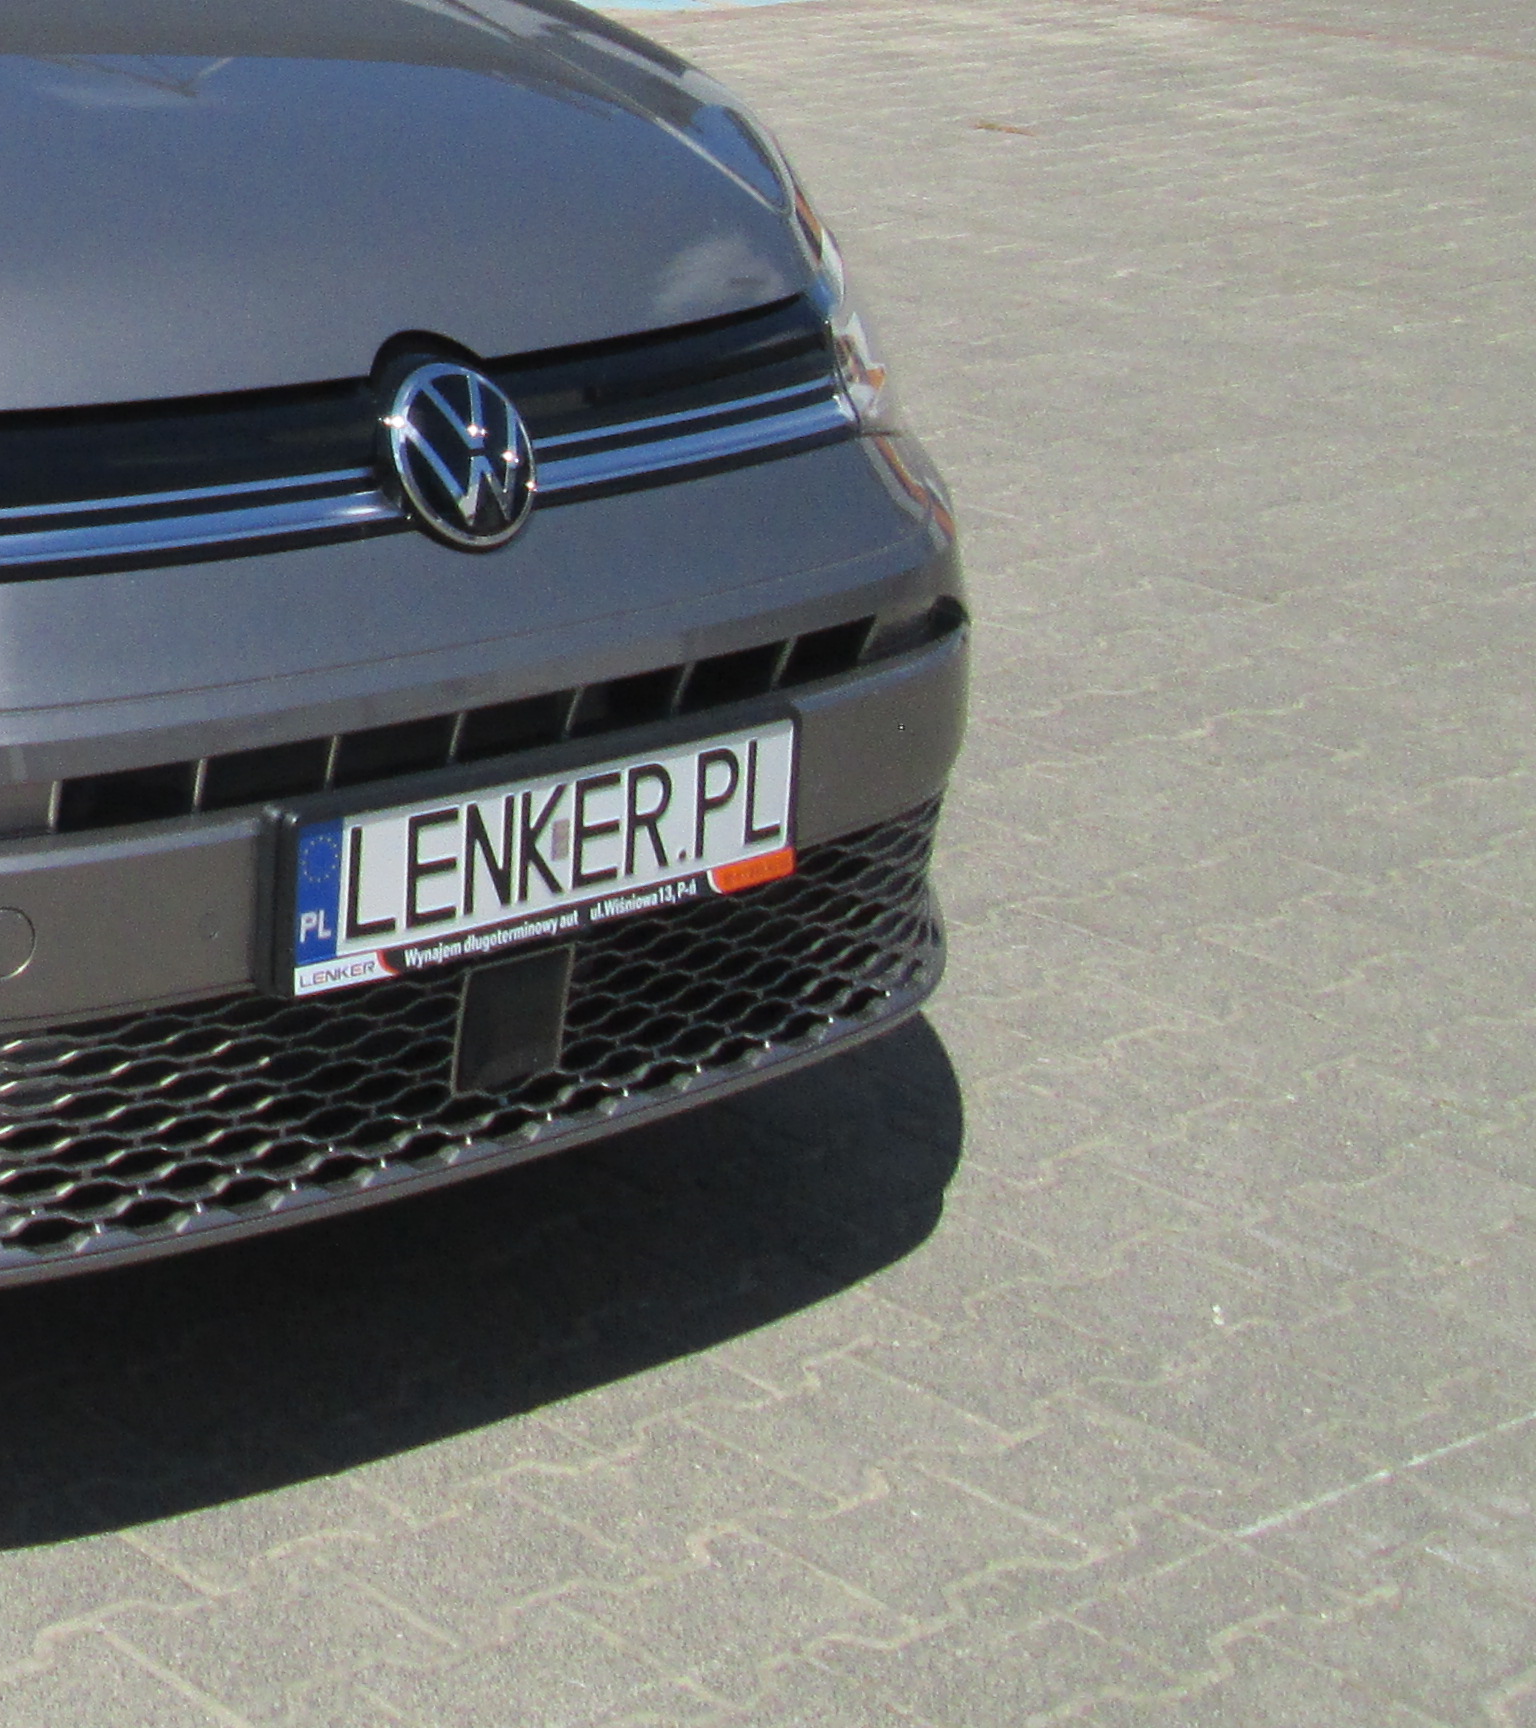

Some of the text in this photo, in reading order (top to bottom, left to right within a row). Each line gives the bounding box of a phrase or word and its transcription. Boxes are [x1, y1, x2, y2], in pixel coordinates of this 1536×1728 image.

[344, 738, 782, 941] LENKER.PL
[299, 907, 332, 944] PL
[403, 940, 462, 969] Wynajem
[559, 909, 579, 929] aut
[299, 958, 375, 988] LENKER
